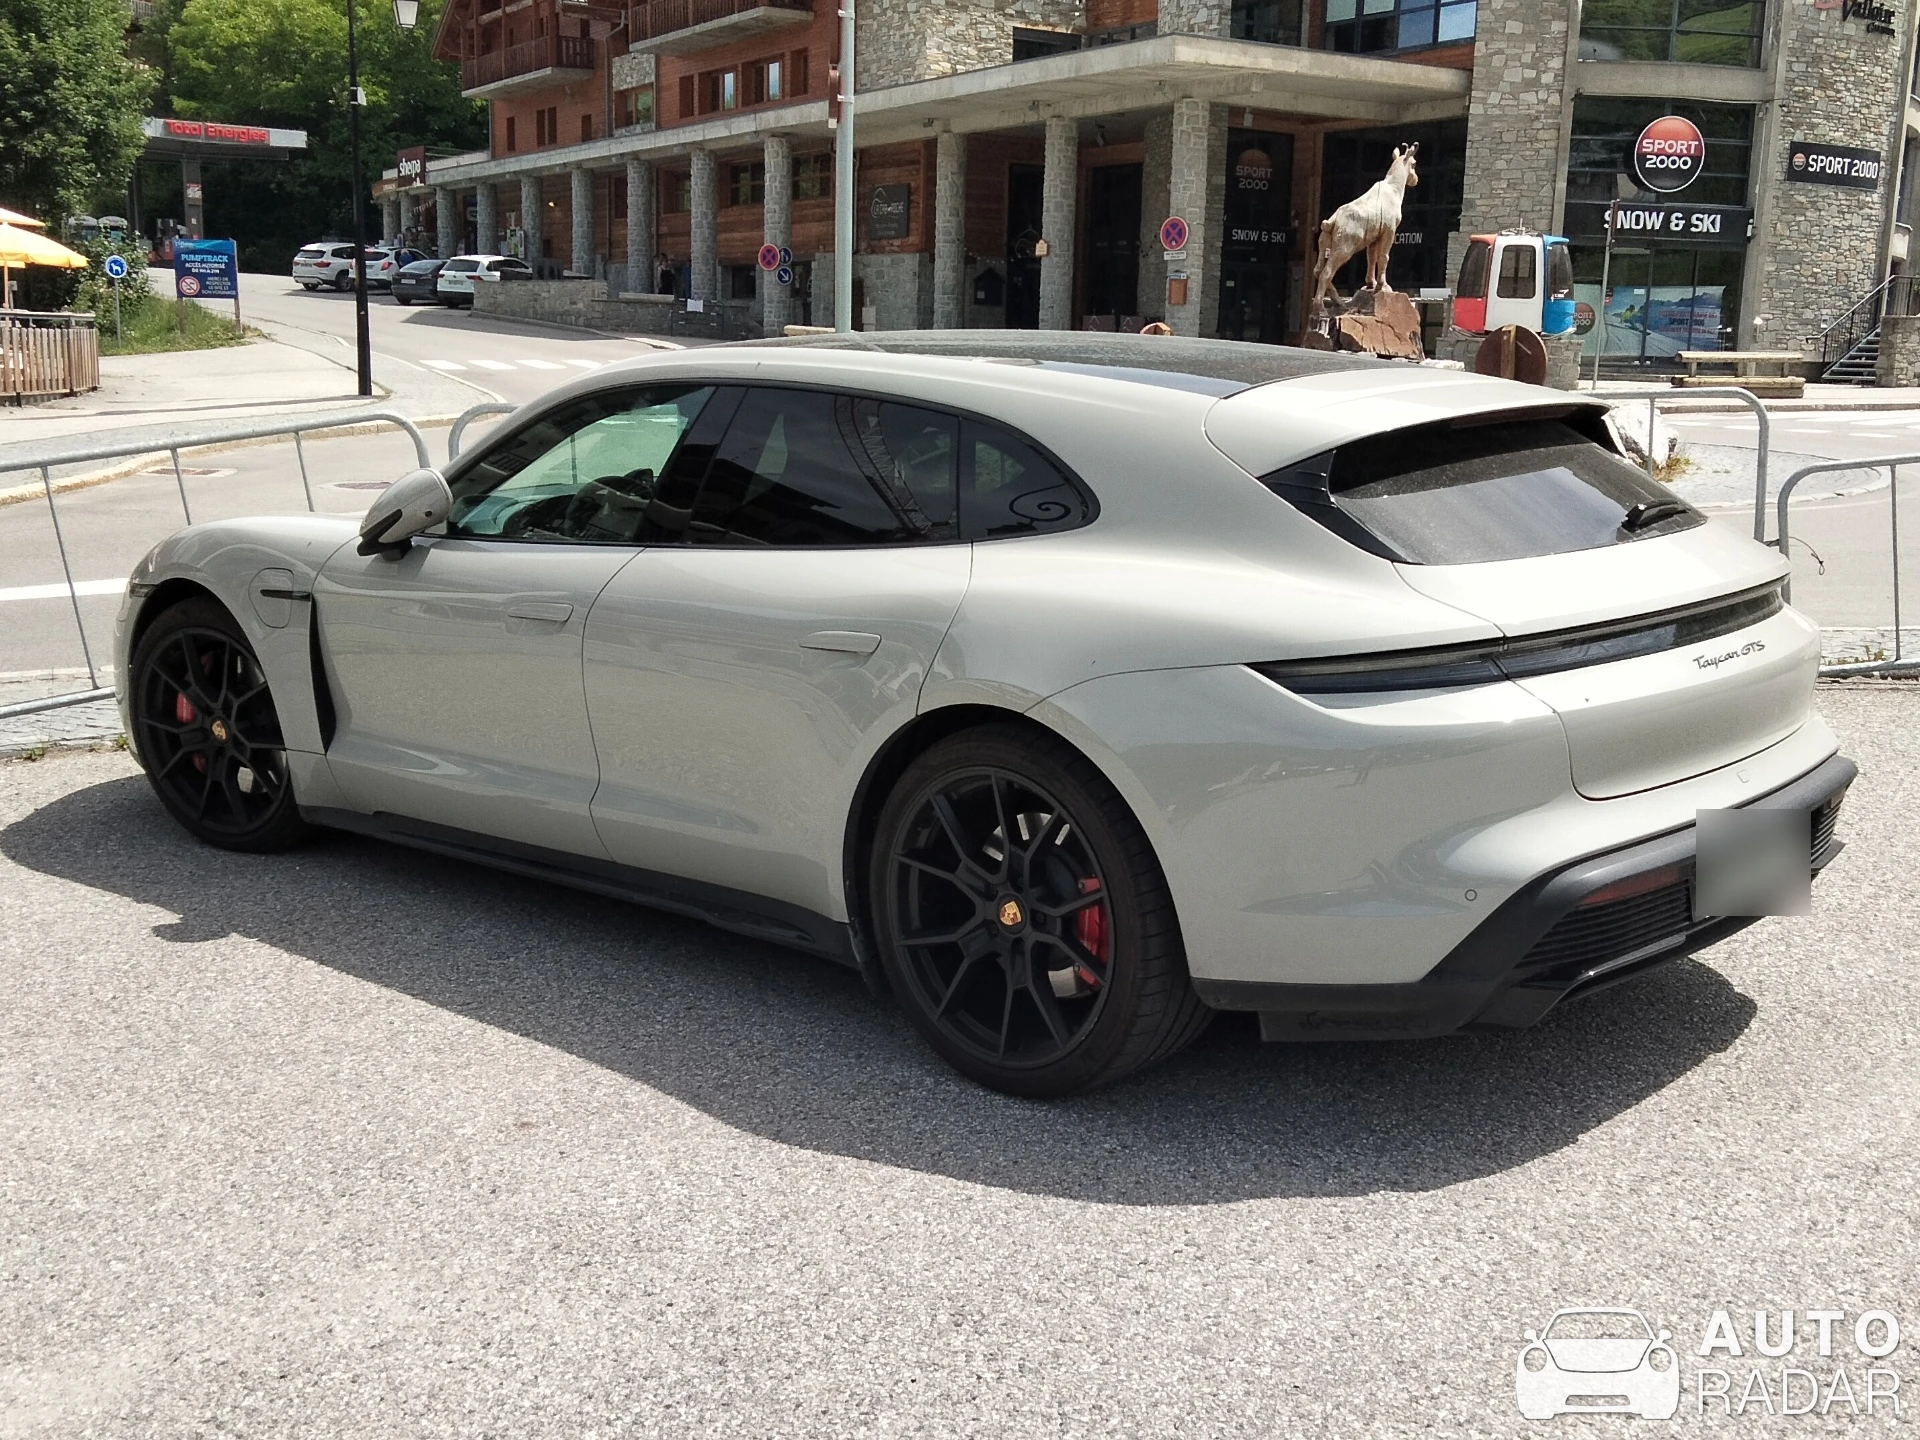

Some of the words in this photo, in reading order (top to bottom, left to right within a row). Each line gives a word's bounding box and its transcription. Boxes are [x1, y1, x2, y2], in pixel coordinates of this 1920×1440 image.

[167, 121, 203, 136] Total
[206, 124, 268, 142] Energies
[1642, 139, 1699, 154] SPORT
[1645, 154, 1692, 169] 2000
[1808, 154, 1852, 175] SPORT
[1851, 159, 1879, 179] 2000
[1236, 165, 1273, 179] SPORT
[1238, 178, 1269, 191] 2000
[1669, 212, 1686, 231] &
[1689, 213, 1721, 233] SKI
[1232, 229, 1259, 241] SNOW
[1261, 231, 1268, 242] &
[1271, 232, 1286, 243] SKI
[1395, 232, 1422, 244] CATION
[181, 254, 228, 262] PUMPTRACK
[1693, 651, 1740, 670] Taycan
[1741, 640, 1766, 656] GTS
